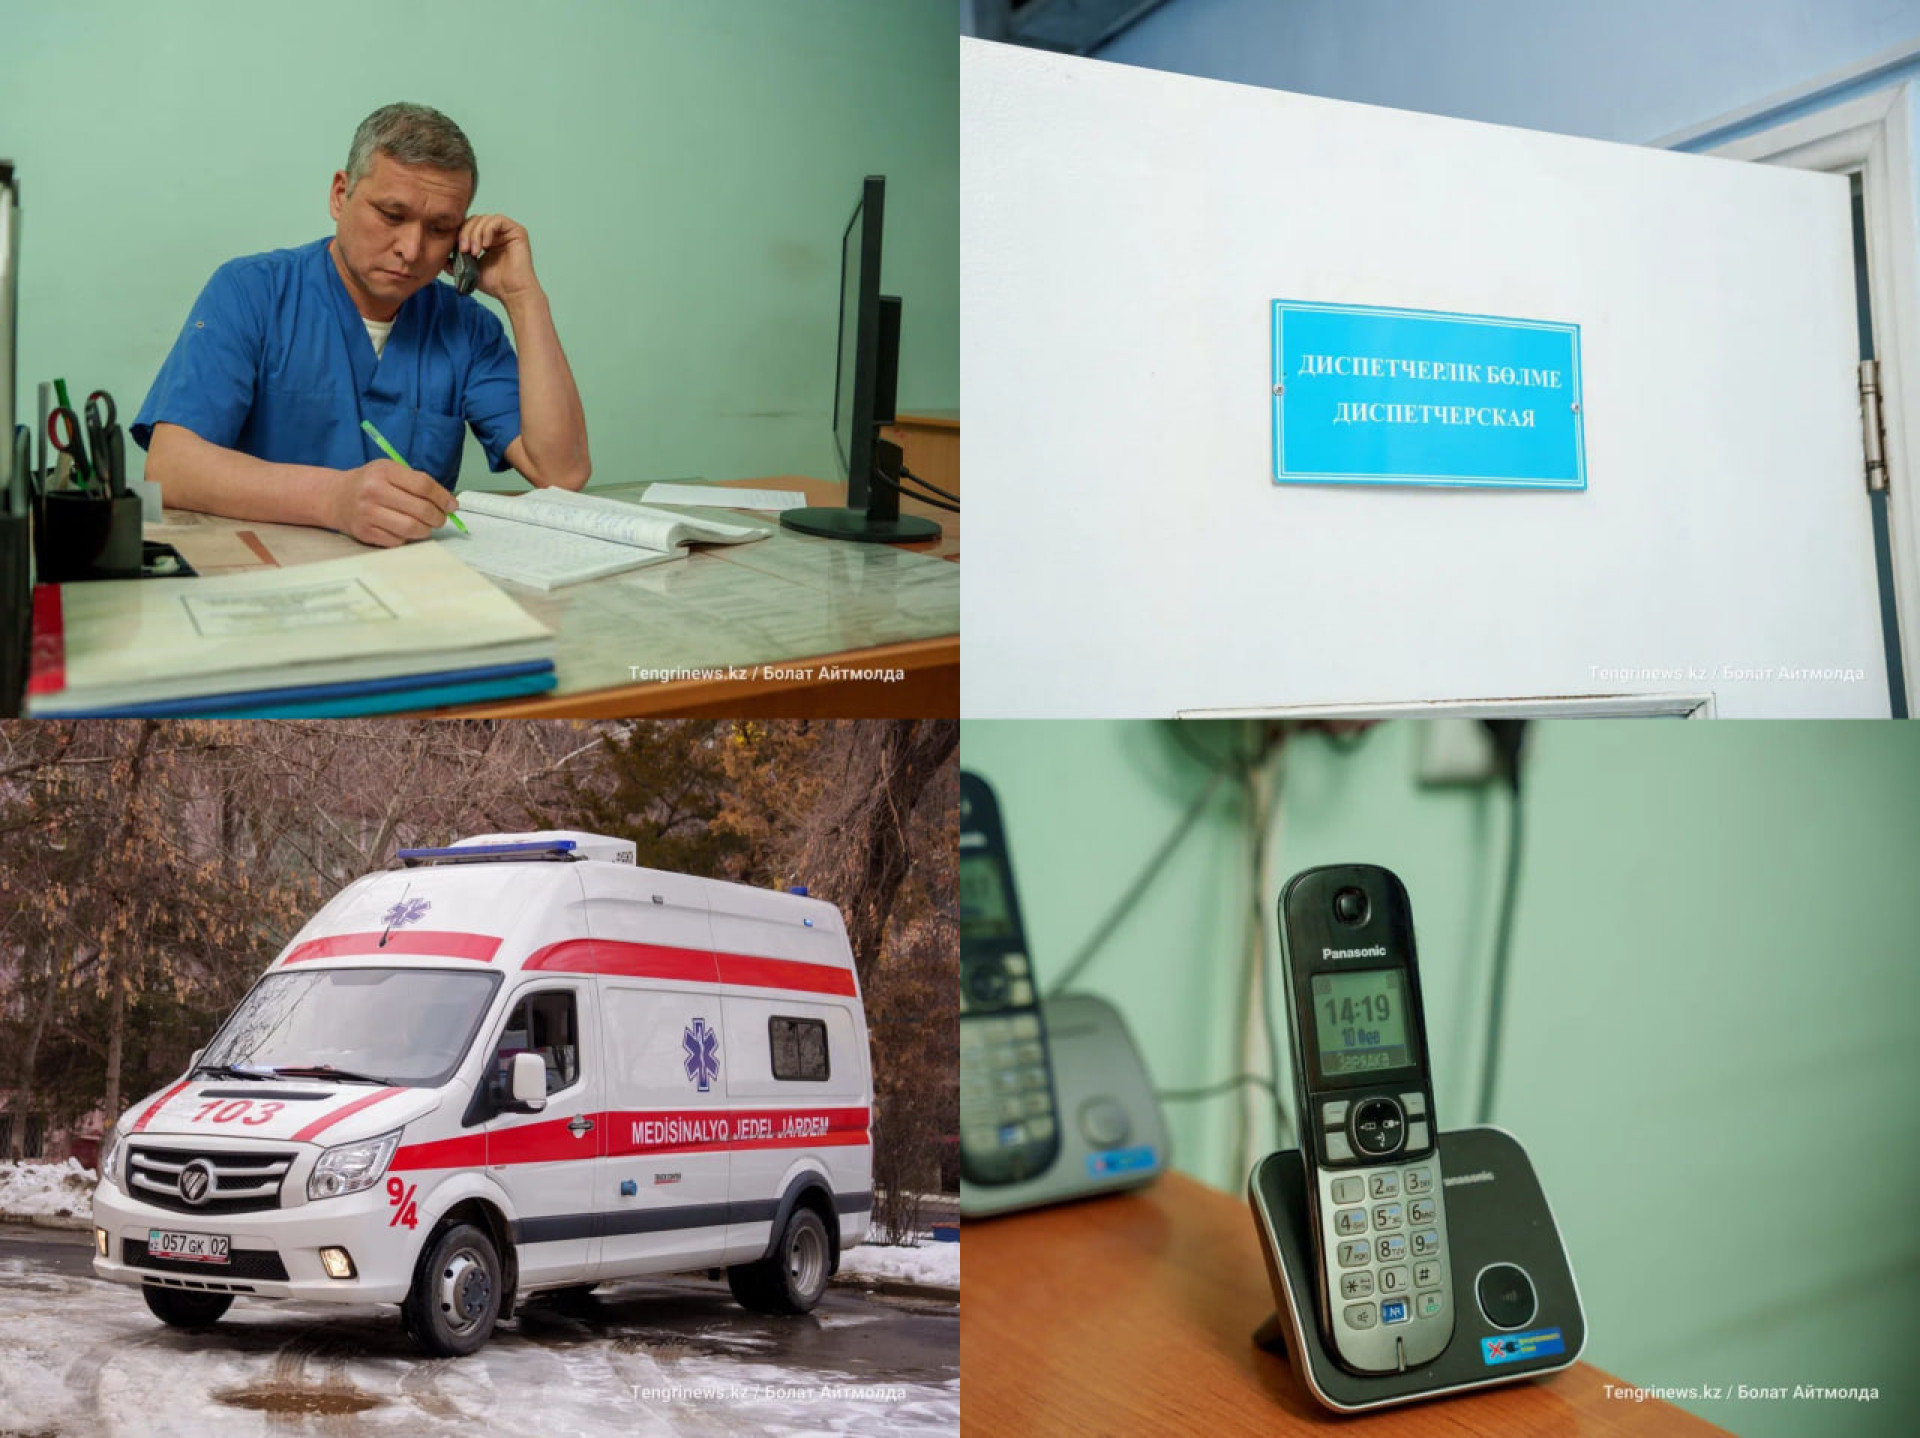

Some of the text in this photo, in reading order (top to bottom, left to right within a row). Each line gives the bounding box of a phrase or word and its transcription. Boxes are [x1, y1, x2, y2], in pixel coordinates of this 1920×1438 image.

[1298, 354, 1563, 388] ДИСПЕТЧЕРЛІК БӨЛМЕ
[1333, 402, 1536, 428] ДИСПЕТЧЕРСКАЯ
[1322, 944, 1387, 960] Panasonic
[1324, 993, 1391, 1026] 14:19
[192, 1100, 285, 1126] 103
[733, 1118, 773, 1140] JEDEL
[1375, 1178, 1384, 1194] 2
[1408, 1173, 1418, 1189] 3
[1341, 1215, 1351, 1231] 4
[1377, 1209, 1387, 1226] 5
[1412, 1203, 1421, 1220] 6
[162, 1234, 228, 1256] 057 GK 02
[1343, 1246, 1353, 1261] 7
[1381, 1241, 1391, 1257] 8
[1416, 1235, 1425, 1252] 9
[1385, 1272, 1396, 1289] 0
